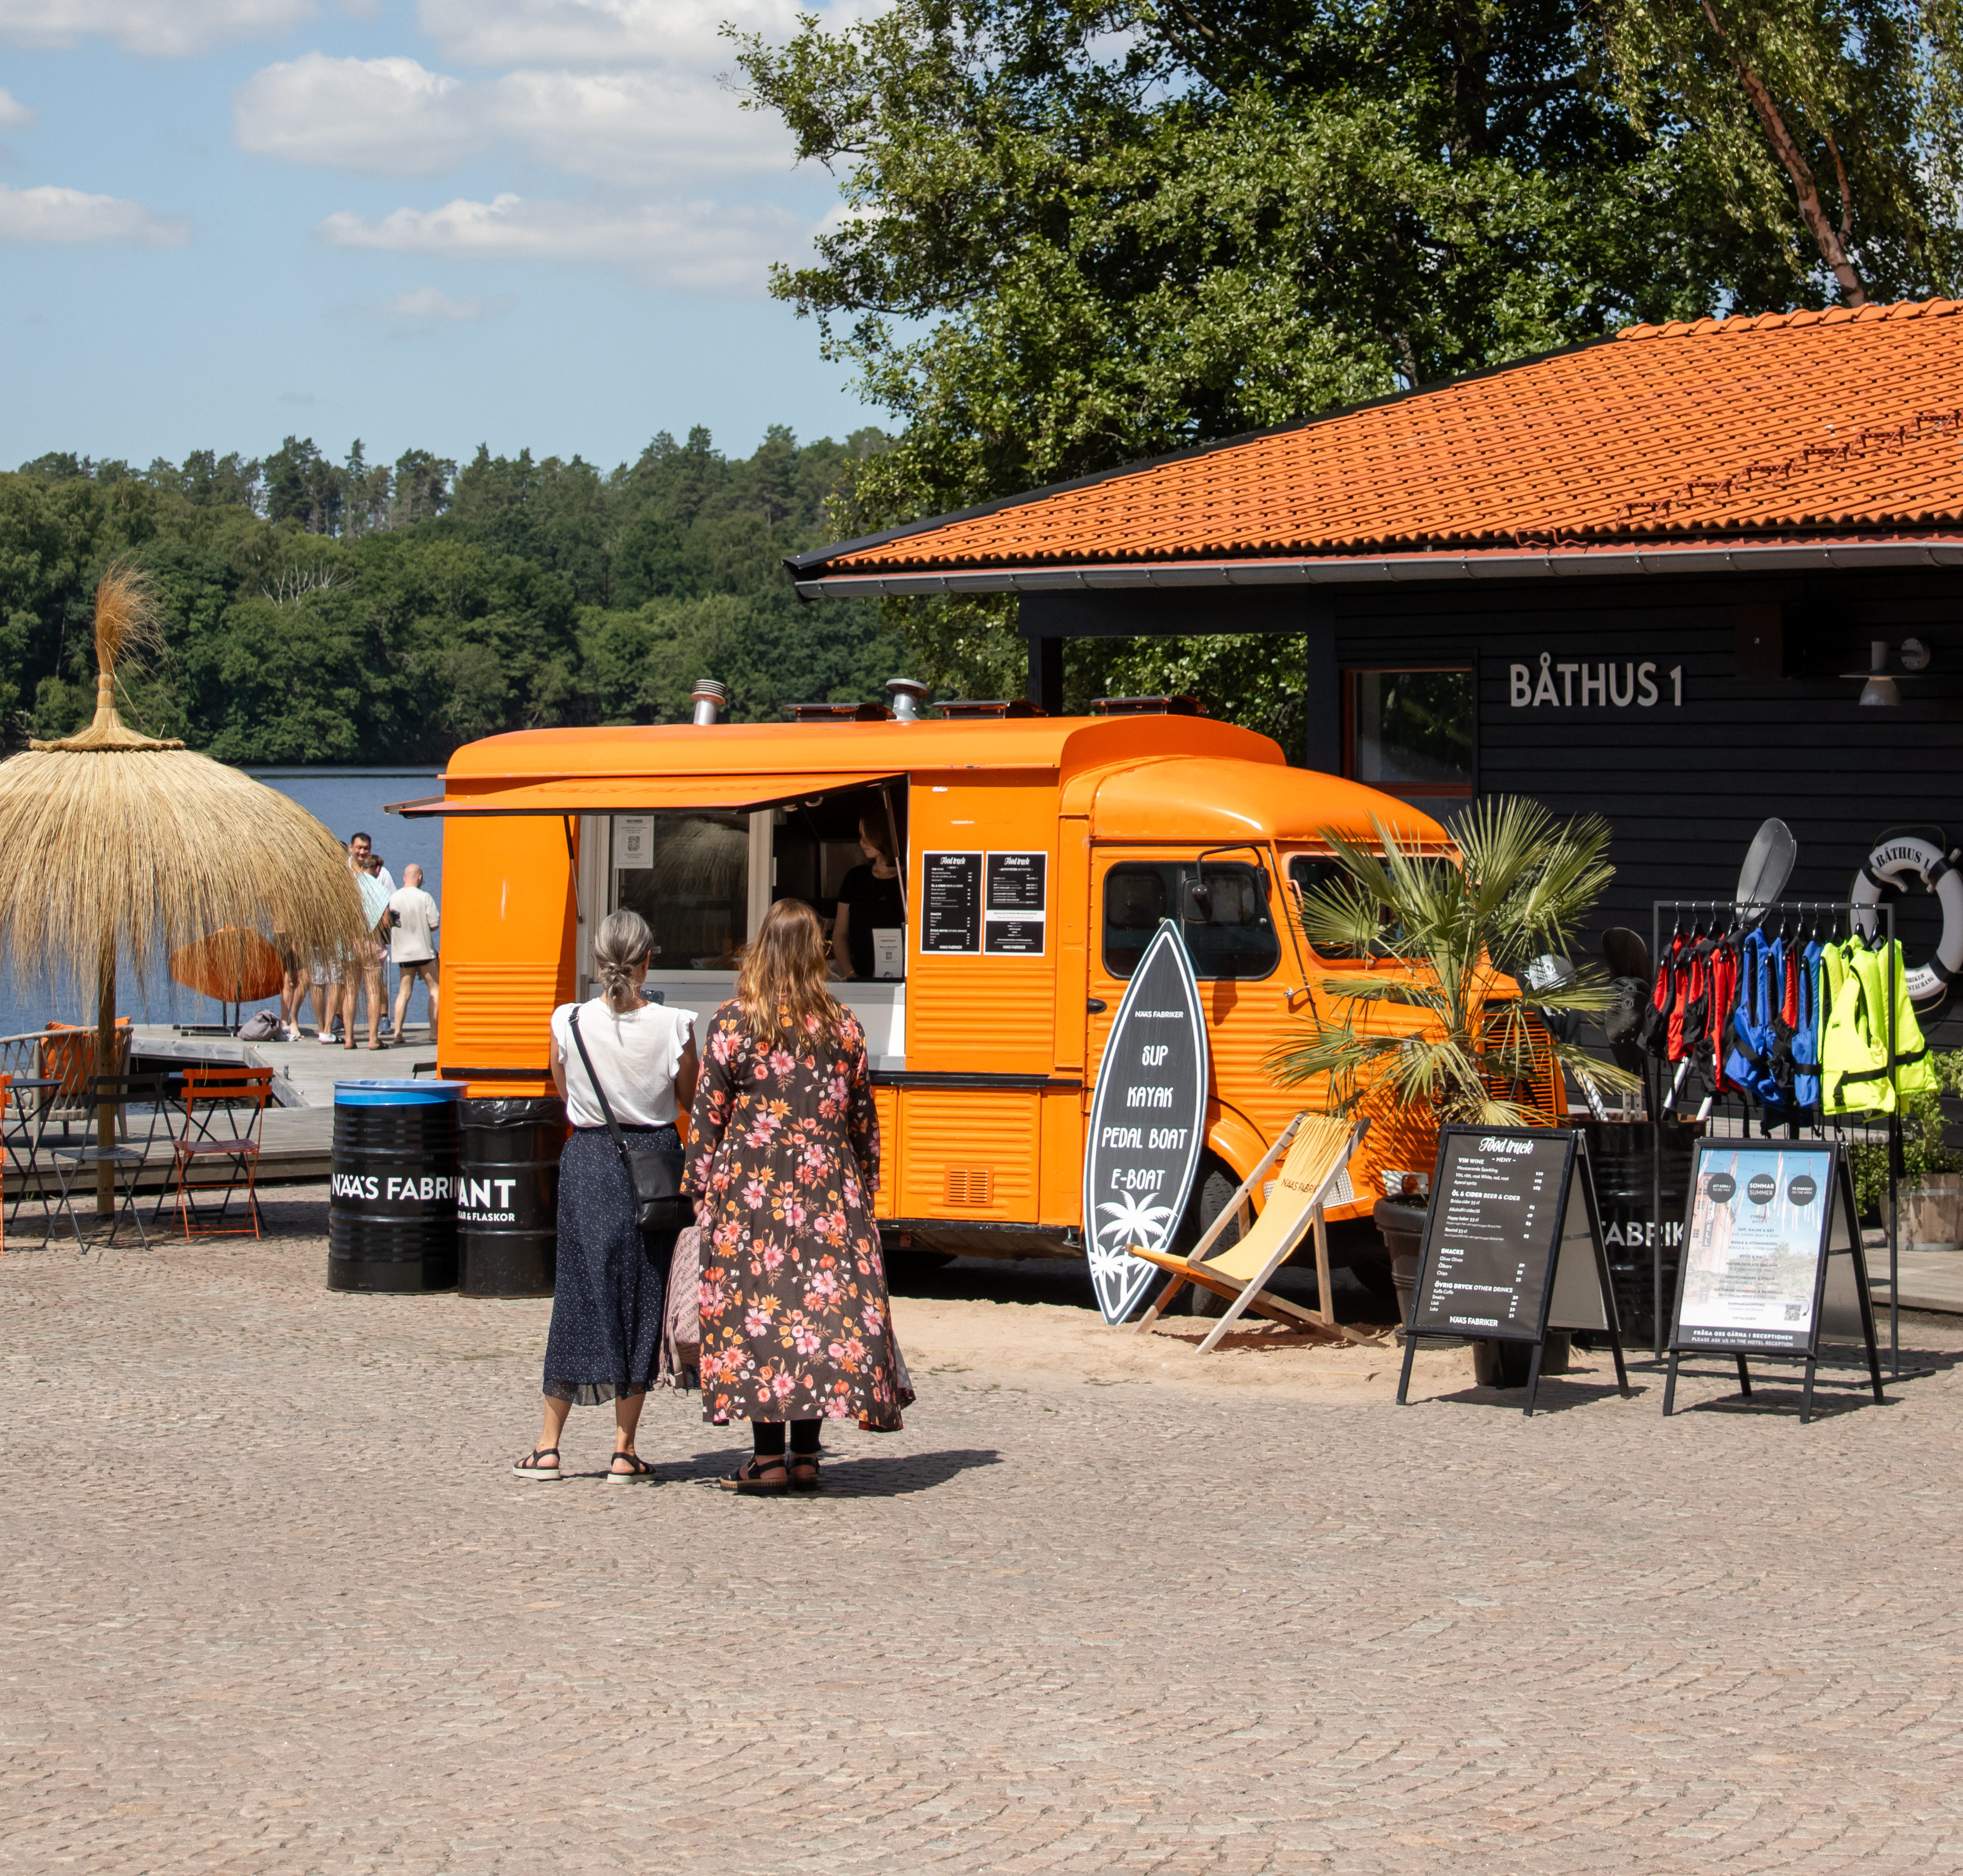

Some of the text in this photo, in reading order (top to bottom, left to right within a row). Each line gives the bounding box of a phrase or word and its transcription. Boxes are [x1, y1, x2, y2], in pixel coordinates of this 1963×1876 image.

[1510, 651, 1681, 707] BÅTHUS 1
[940, 856, 966, 865] Food truck
[1004, 856, 1030, 865] Food truck
[1876, 847, 1930, 868] BÅTHUS 1
[1142, 1046, 1168, 1066] SUP
[1127, 1087, 1173, 1108] KAYAK
[1102, 1127, 1188, 1150] PEDAL BOAT
[1479, 1136, 1533, 1155] Food truck
[332, 1173, 379, 1200] NÄÄS
[1111, 1169, 1165, 1190] E-BOAT
[458, 1177, 516, 1208] ANT
[467, 1212, 471, 1221] &
[472, 1212, 515, 1222] FLASKOR
[1435, 1280, 1453, 1289] ÖVRIG
[1467, 1317, 1498, 1327] FABRIKER
